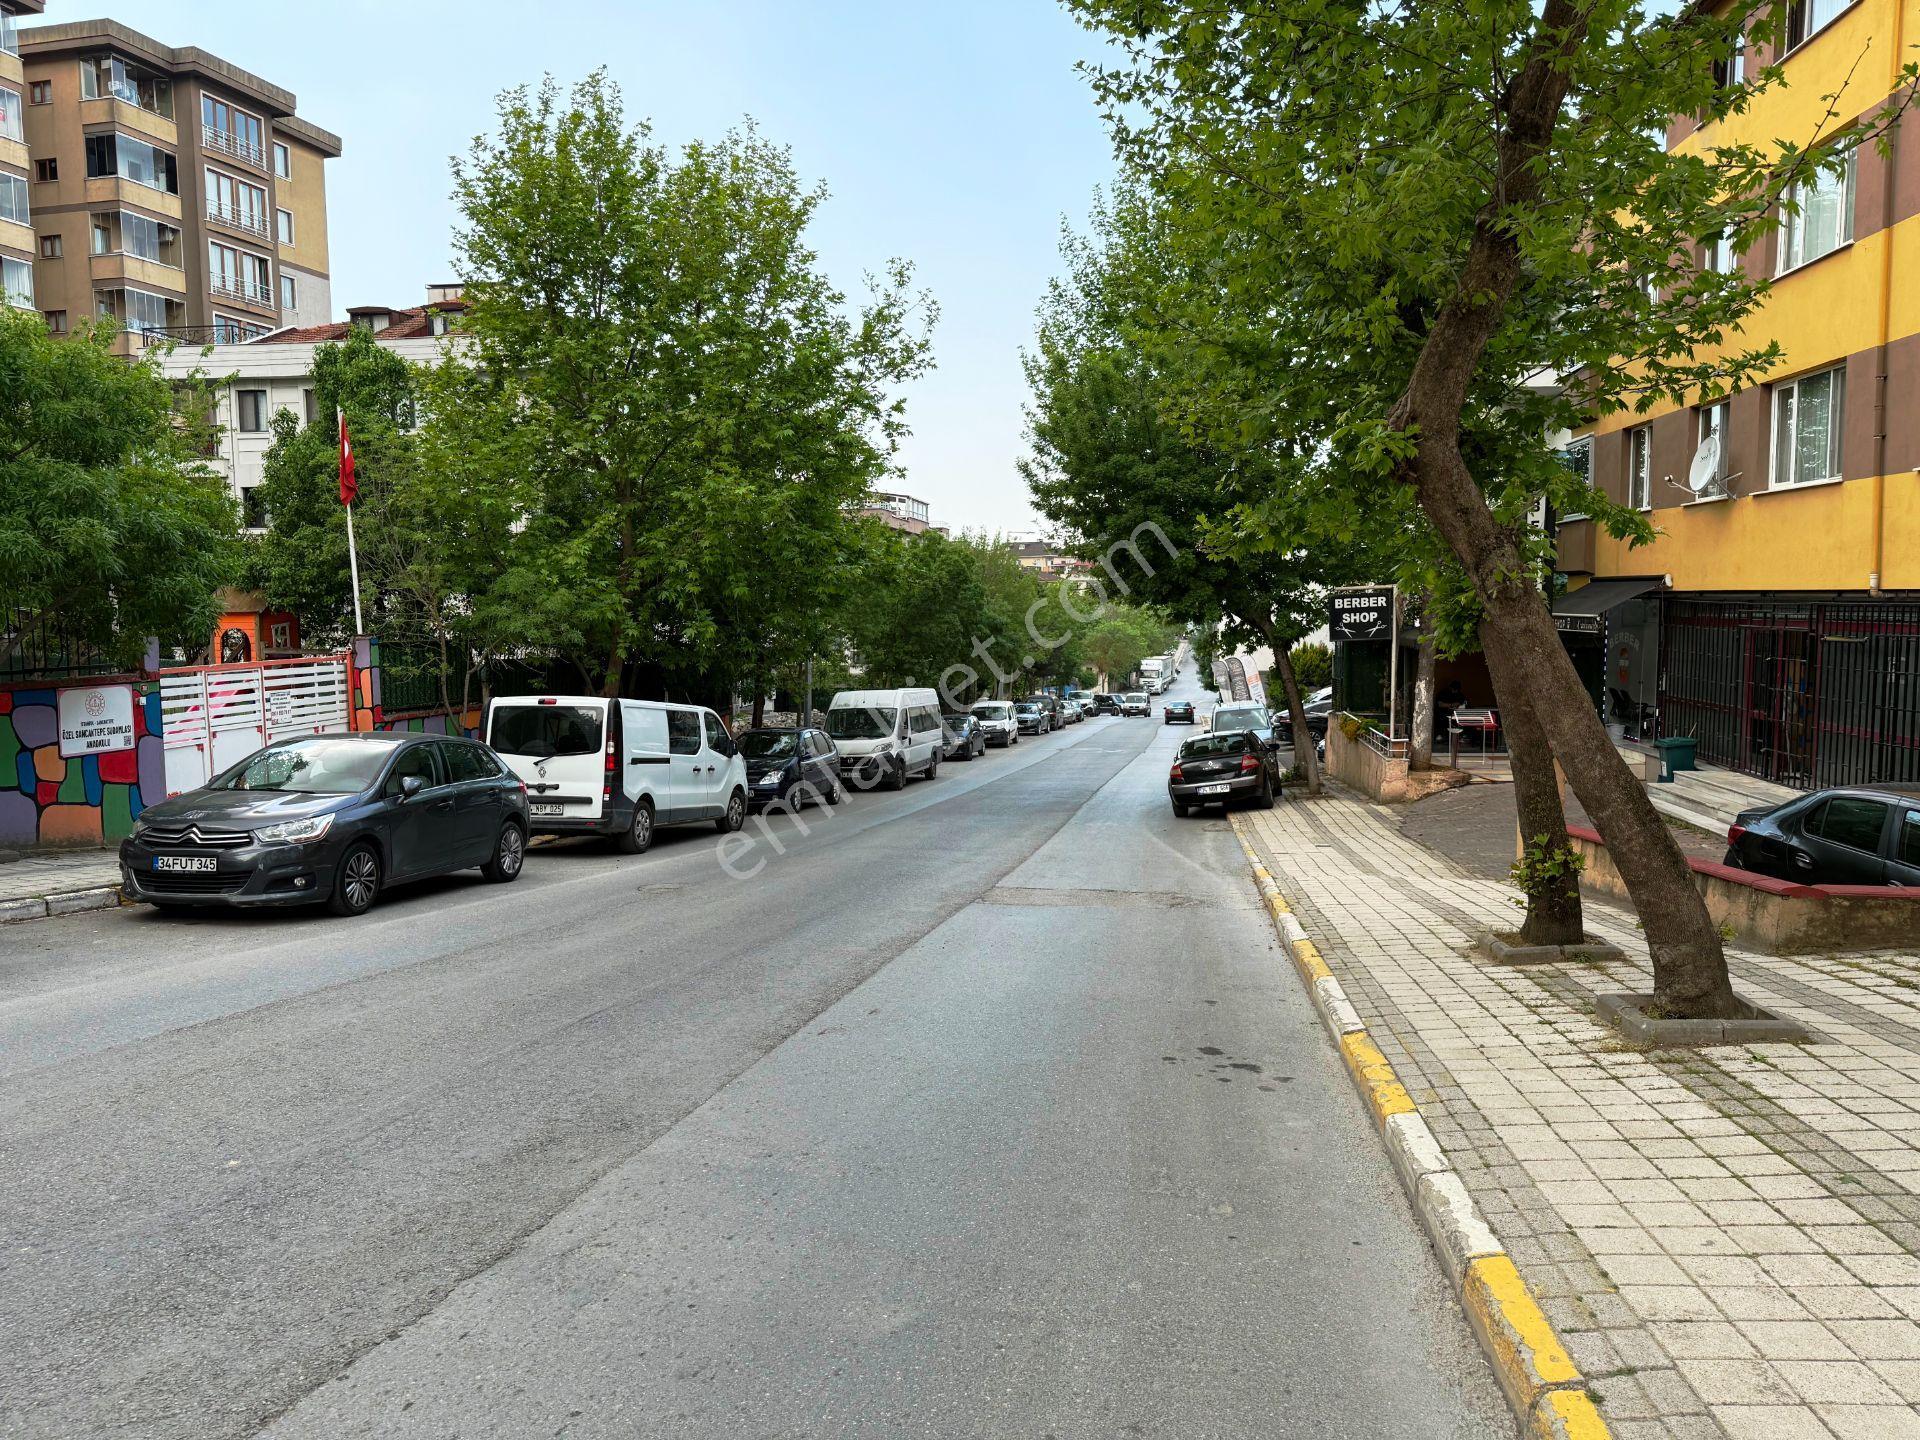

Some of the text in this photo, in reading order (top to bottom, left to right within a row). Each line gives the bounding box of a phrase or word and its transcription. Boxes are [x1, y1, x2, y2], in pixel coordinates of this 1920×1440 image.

[1334, 596, 1387, 609] BERBER
[1342, 612, 1378, 624] SHOP
[1609, 632, 1640, 651] BERBER
[62, 729, 74, 740] ÖZEL
